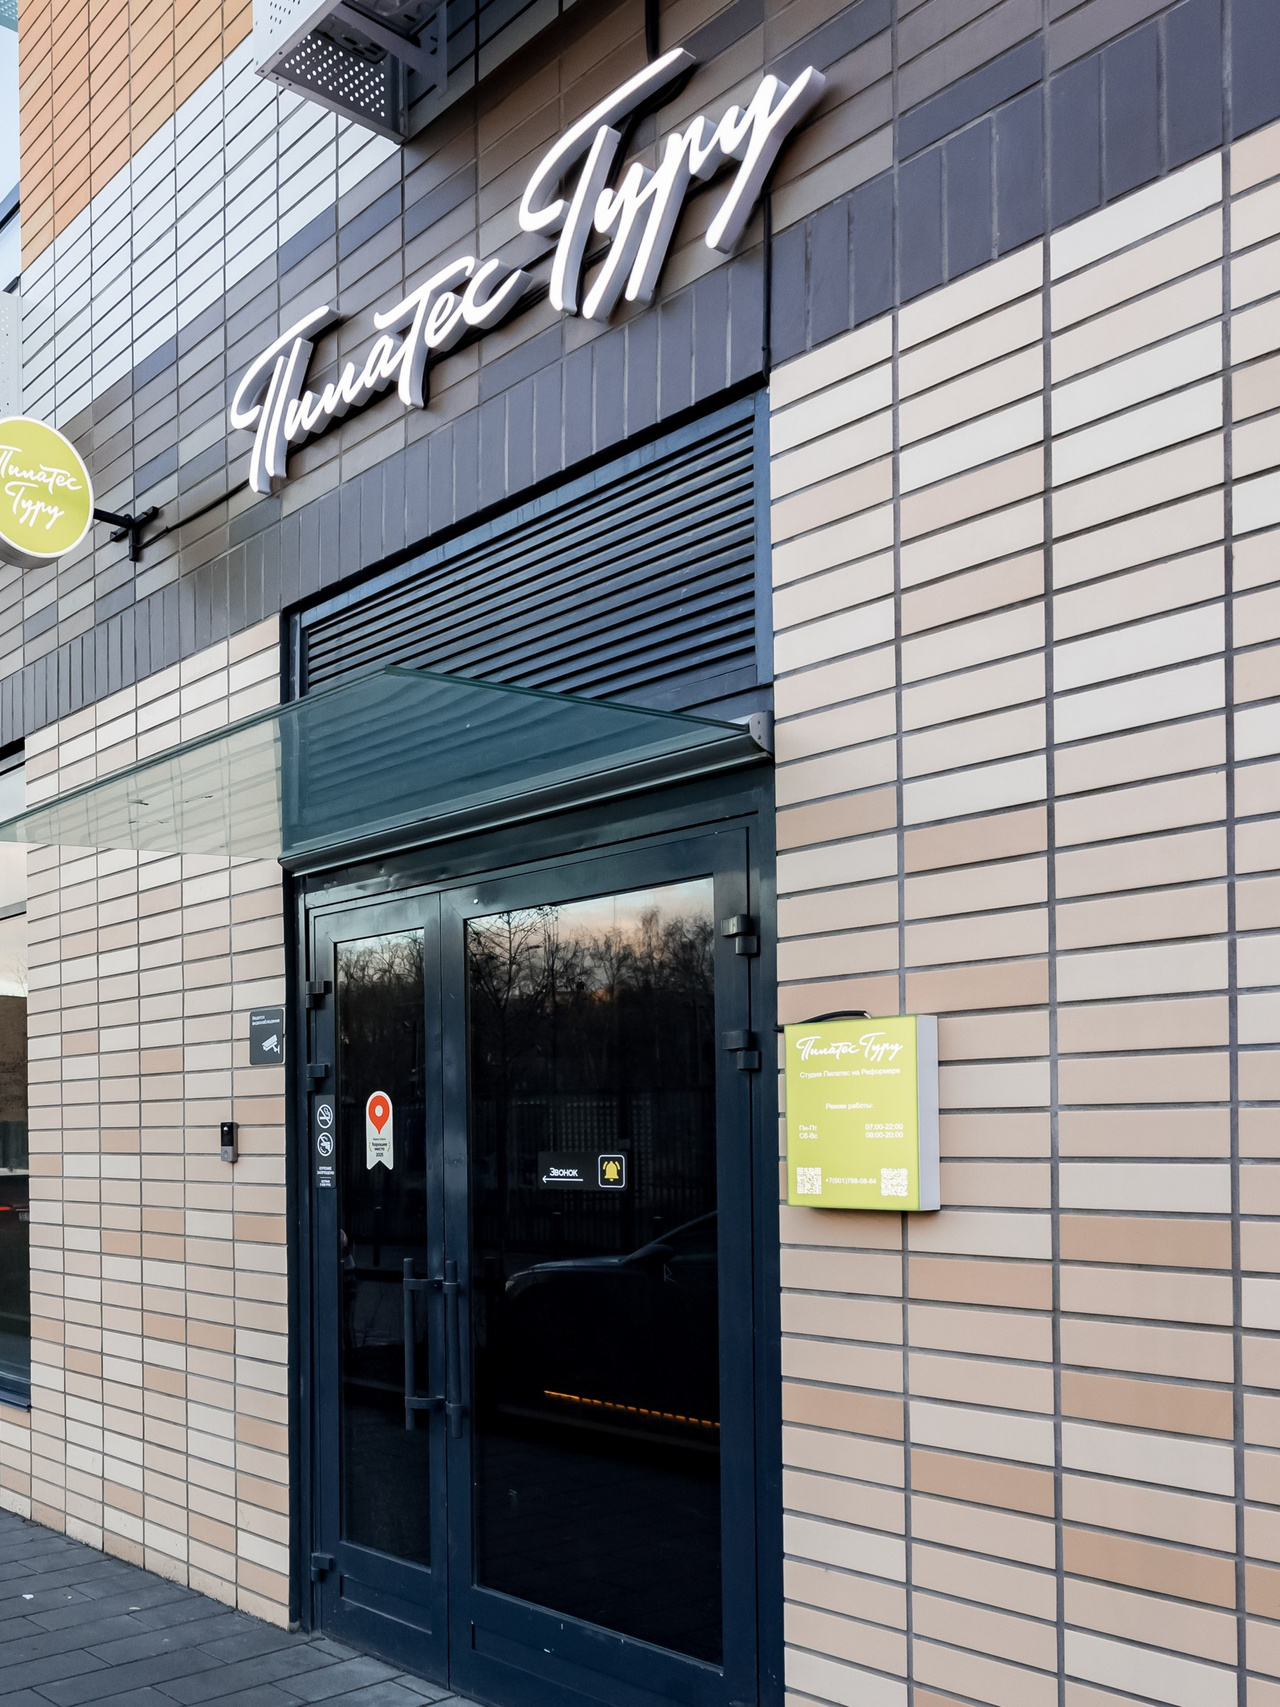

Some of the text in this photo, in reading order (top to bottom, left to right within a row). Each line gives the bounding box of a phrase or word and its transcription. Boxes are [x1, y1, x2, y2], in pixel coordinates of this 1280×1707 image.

[230, 48, 826, 495] Пилатес Гуру
[4, 481, 65, 530] Гуру
[796, 1032, 903, 1062] Пилатес Гуру
[799, 1071, 822, 1079] Студия
[823, 1069, 851, 1077] Пилатес
[825, 1102, 847, 1110] Режим
